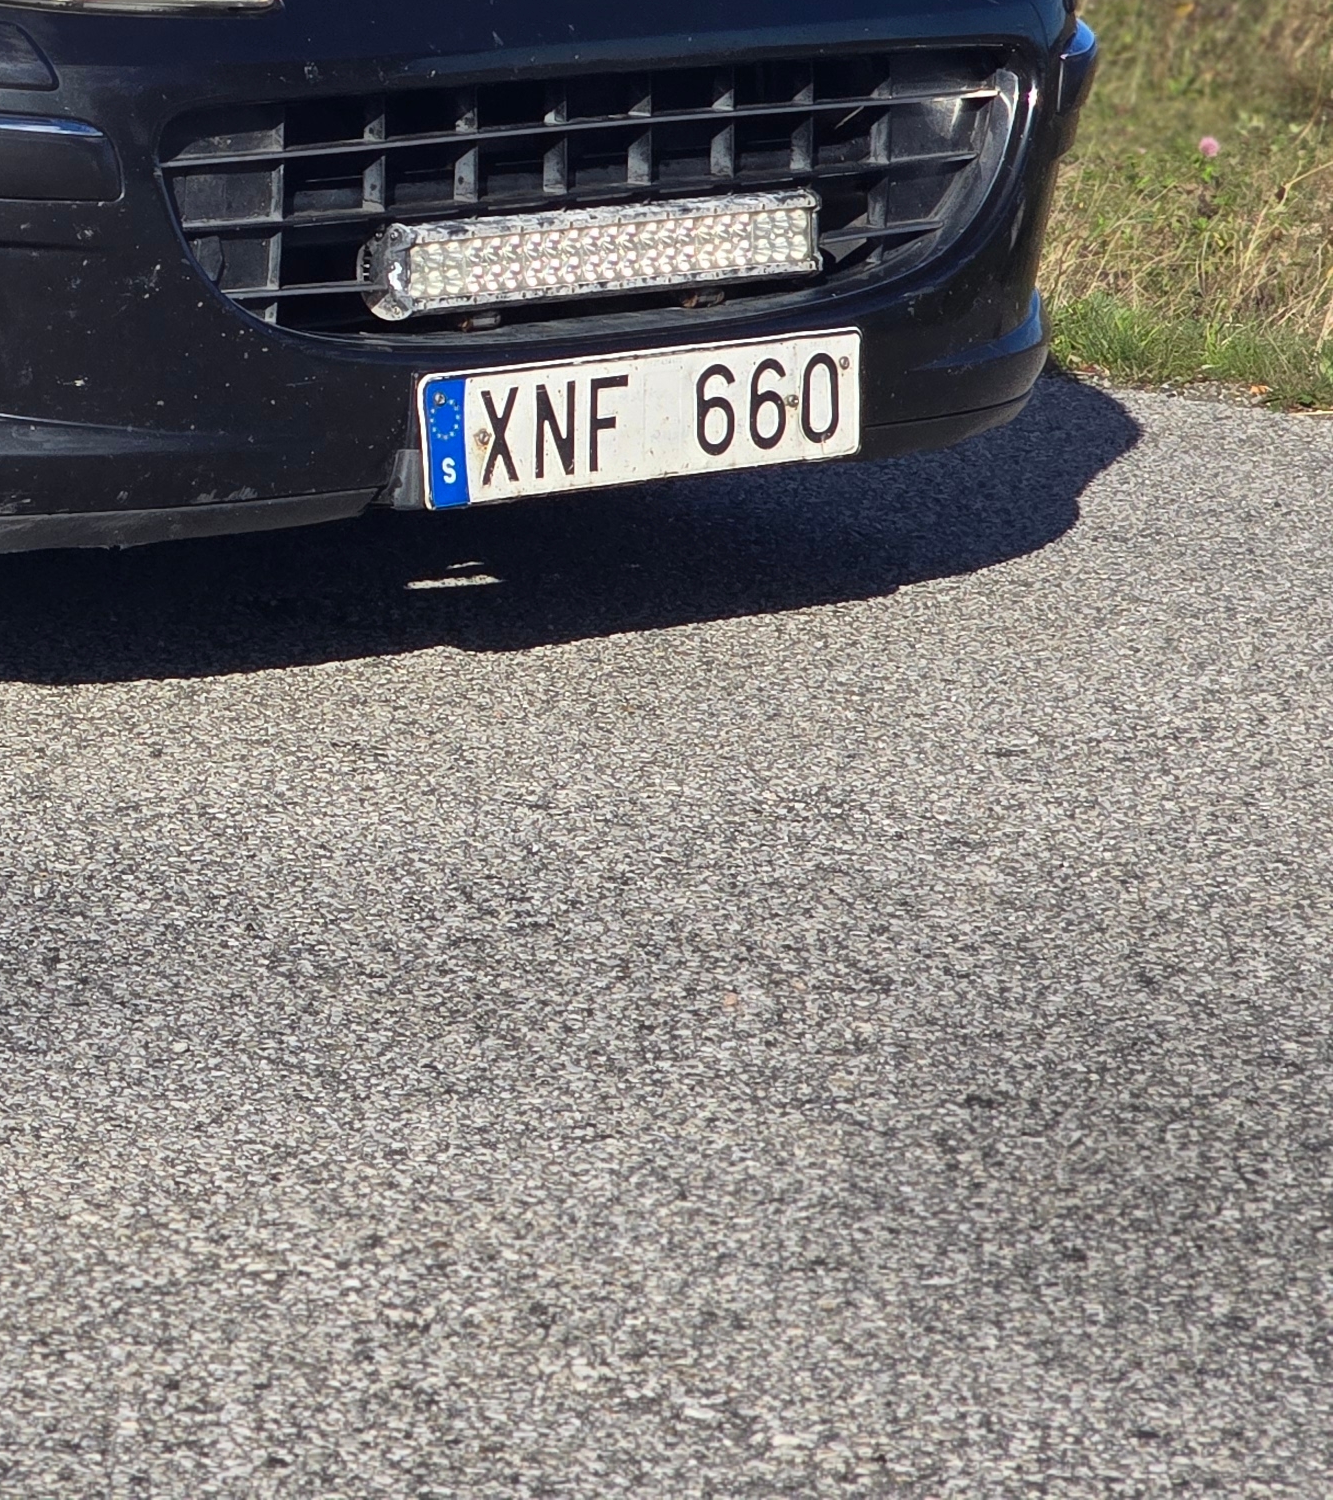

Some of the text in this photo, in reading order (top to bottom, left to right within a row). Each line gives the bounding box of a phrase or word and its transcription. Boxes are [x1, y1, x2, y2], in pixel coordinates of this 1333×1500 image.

[481, 351, 840, 487] XNF 660
[441, 456, 456, 485] S
